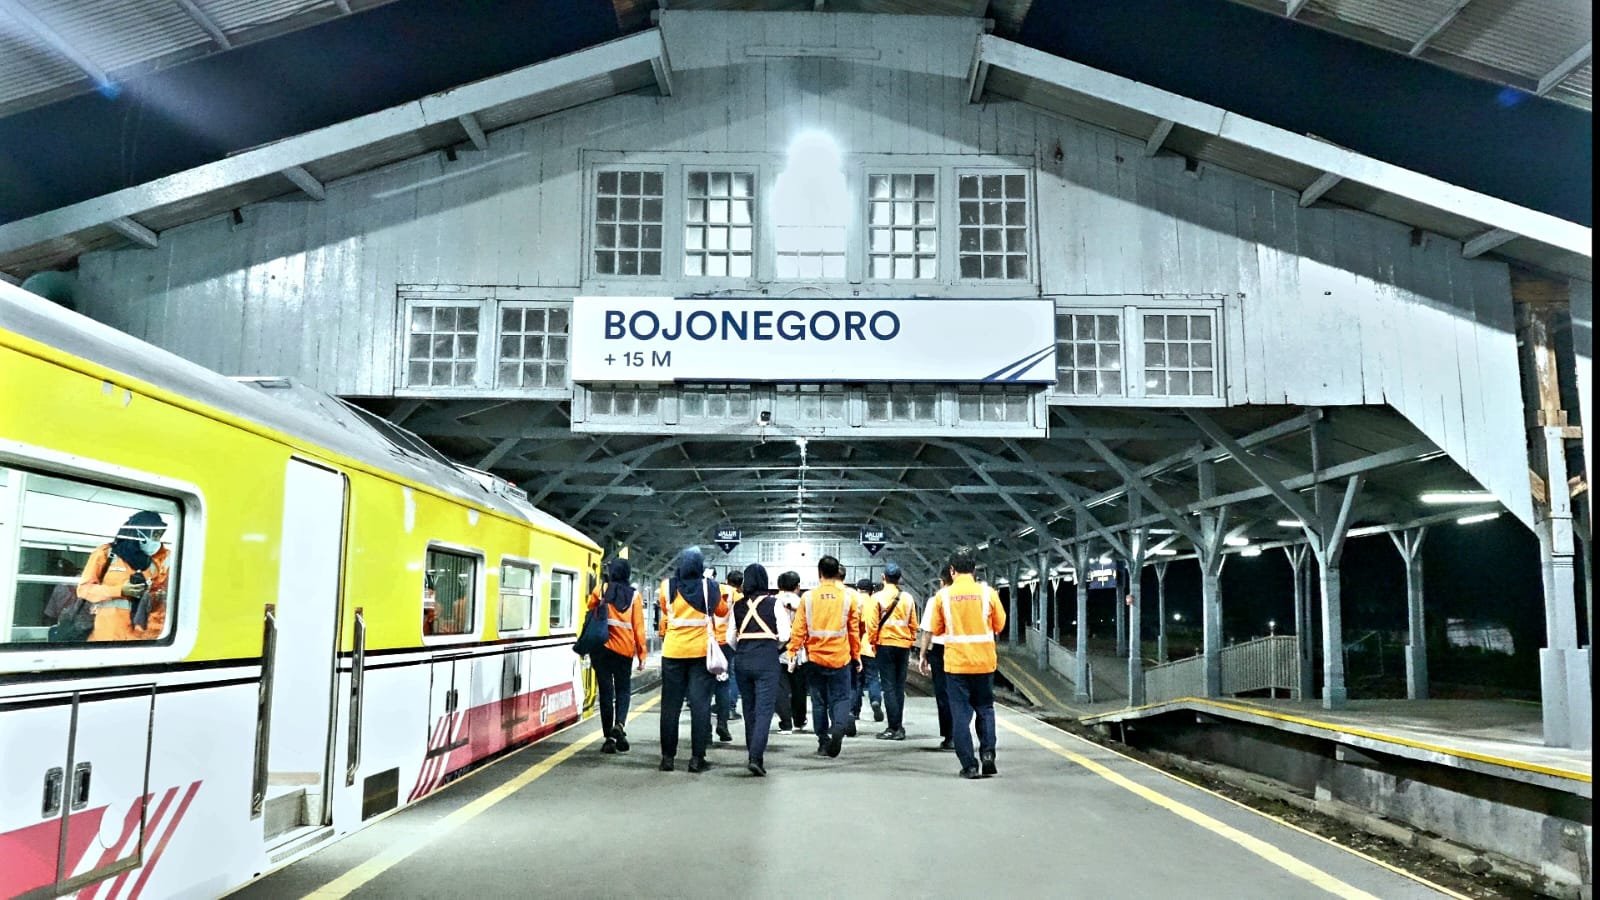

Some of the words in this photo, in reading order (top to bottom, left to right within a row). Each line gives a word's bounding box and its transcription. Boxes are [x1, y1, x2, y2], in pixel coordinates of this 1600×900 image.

[604, 310, 901, 341] BOJONEGORO
[604, 353, 616, 366] +
[623, 351, 644, 367] 15
[651, 350, 672, 367] M
